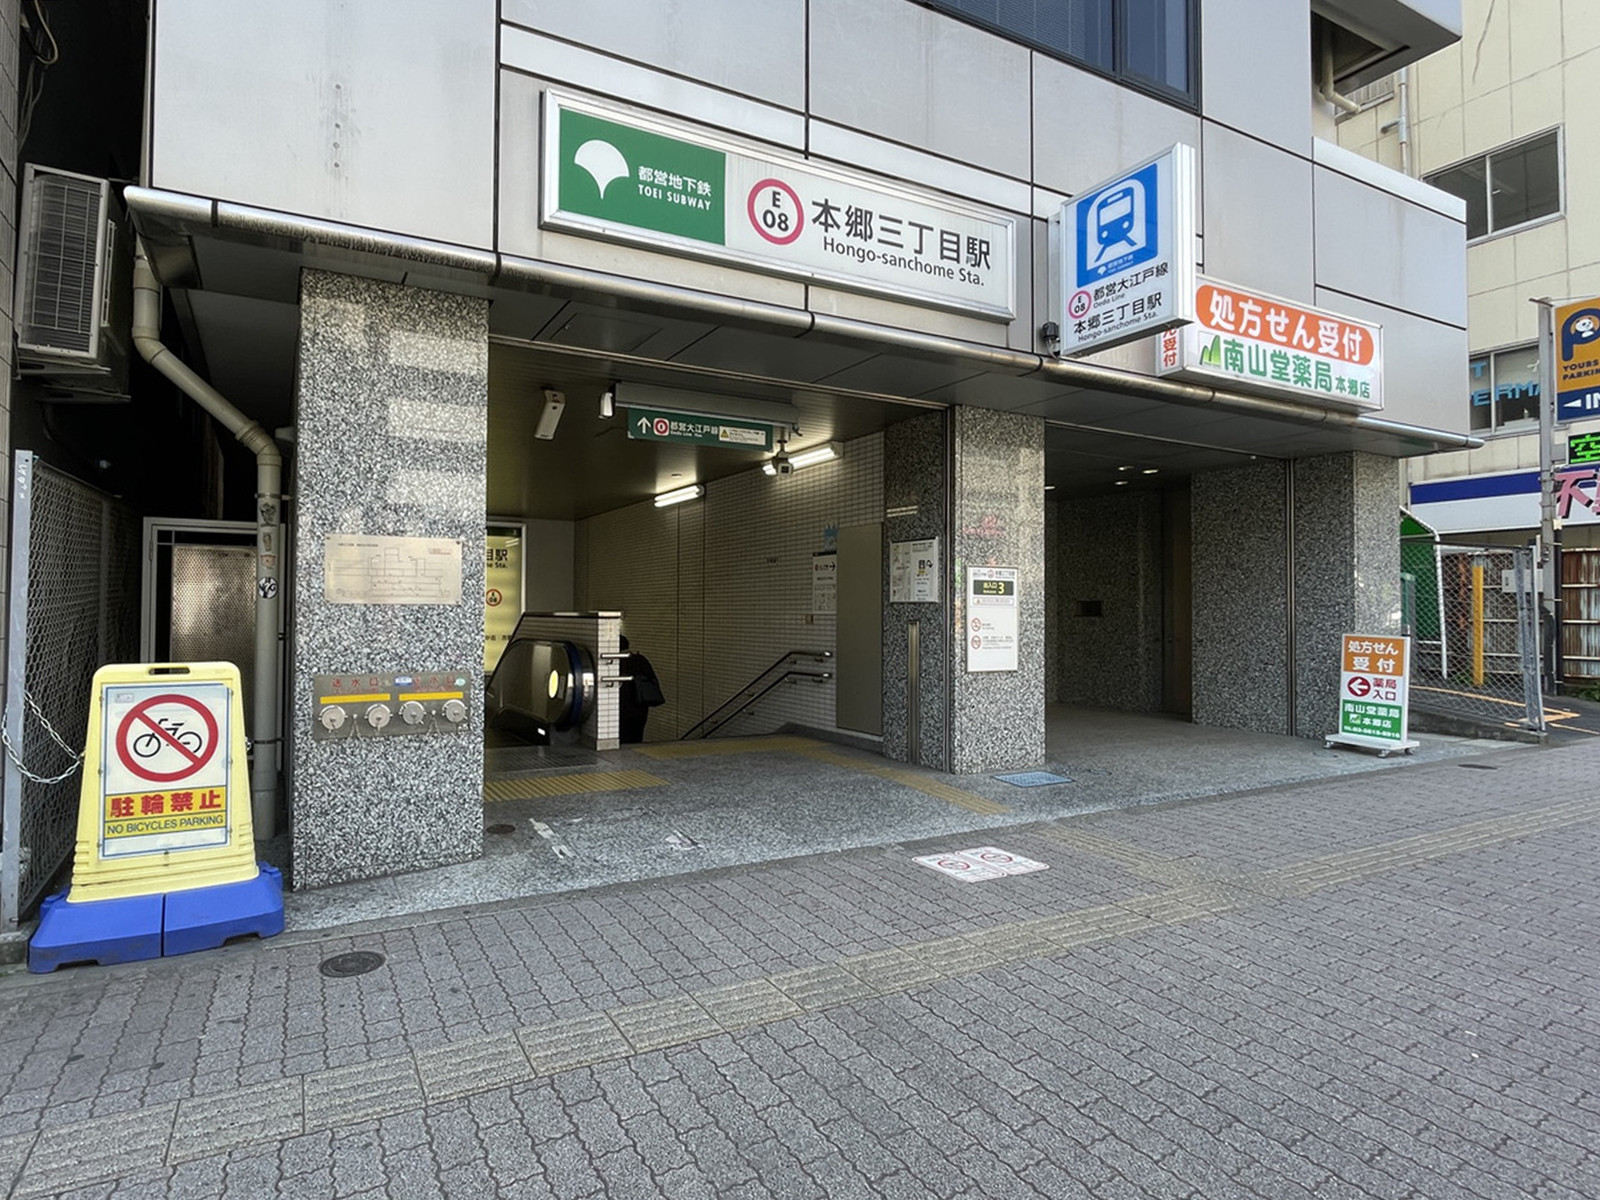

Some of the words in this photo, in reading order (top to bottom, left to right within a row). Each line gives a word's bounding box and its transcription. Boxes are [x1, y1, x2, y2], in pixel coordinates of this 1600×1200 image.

[638, 165, 712, 197] 都営地下鉄
[637, 184, 663, 200] TOEI
[666, 191, 711, 211] SUBWAY
[771, 190, 781, 209] E
[762, 209, 790, 233] 08
[811, 198, 991, 271] 本郷三丁目駅
[823, 235, 955, 280] Hongo-sanchome
[959, 267, 985, 287] Sta.
[1093, 261, 1169, 302] 都営大江戸線
[1073, 292, 1162, 335] 本郷三丁目駅
[1209, 289, 1363, 363] 処方せん受付
[1077, 315, 1142, 343] Hongo-sanchome
[1562, 359, 1600, 372] YOURS
[997, 582, 1005, 595] 3
[1348, 640, 1399, 656] 処方せん
[1372, 690, 1396, 701] 入口
[110, 790, 222, 819] 駐輪禁止
[107, 823, 124, 834] NO
[126, 818, 178, 833] BICYCLES
[179, 814, 224, 828] PARKING
